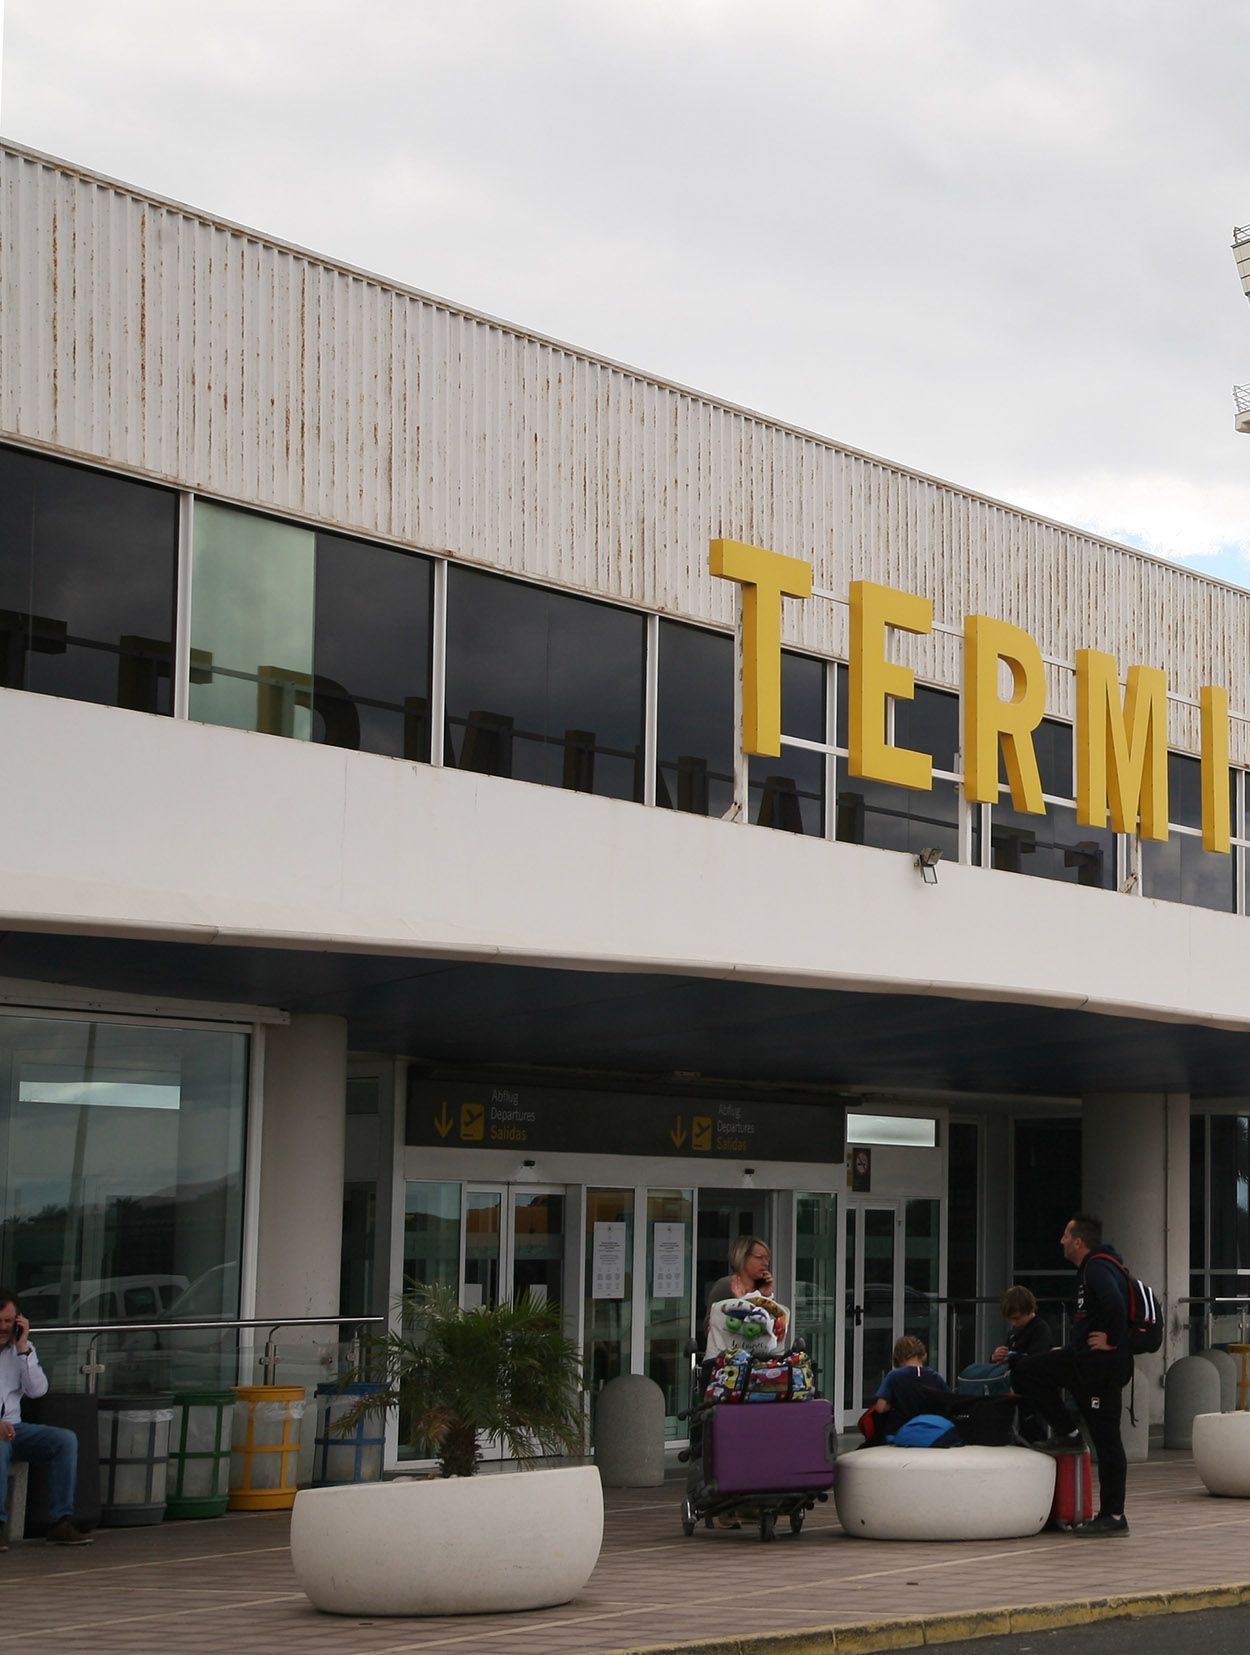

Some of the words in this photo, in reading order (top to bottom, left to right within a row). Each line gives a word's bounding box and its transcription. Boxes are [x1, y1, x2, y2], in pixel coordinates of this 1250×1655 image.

[491, 1088, 519, 1106] Abflug
[490, 1106, 537, 1122] Departures
[490, 1124, 529, 1141] Salidas
[717, 1119, 756, 1135] Departures
[716, 1136, 748, 1153] Salidas
